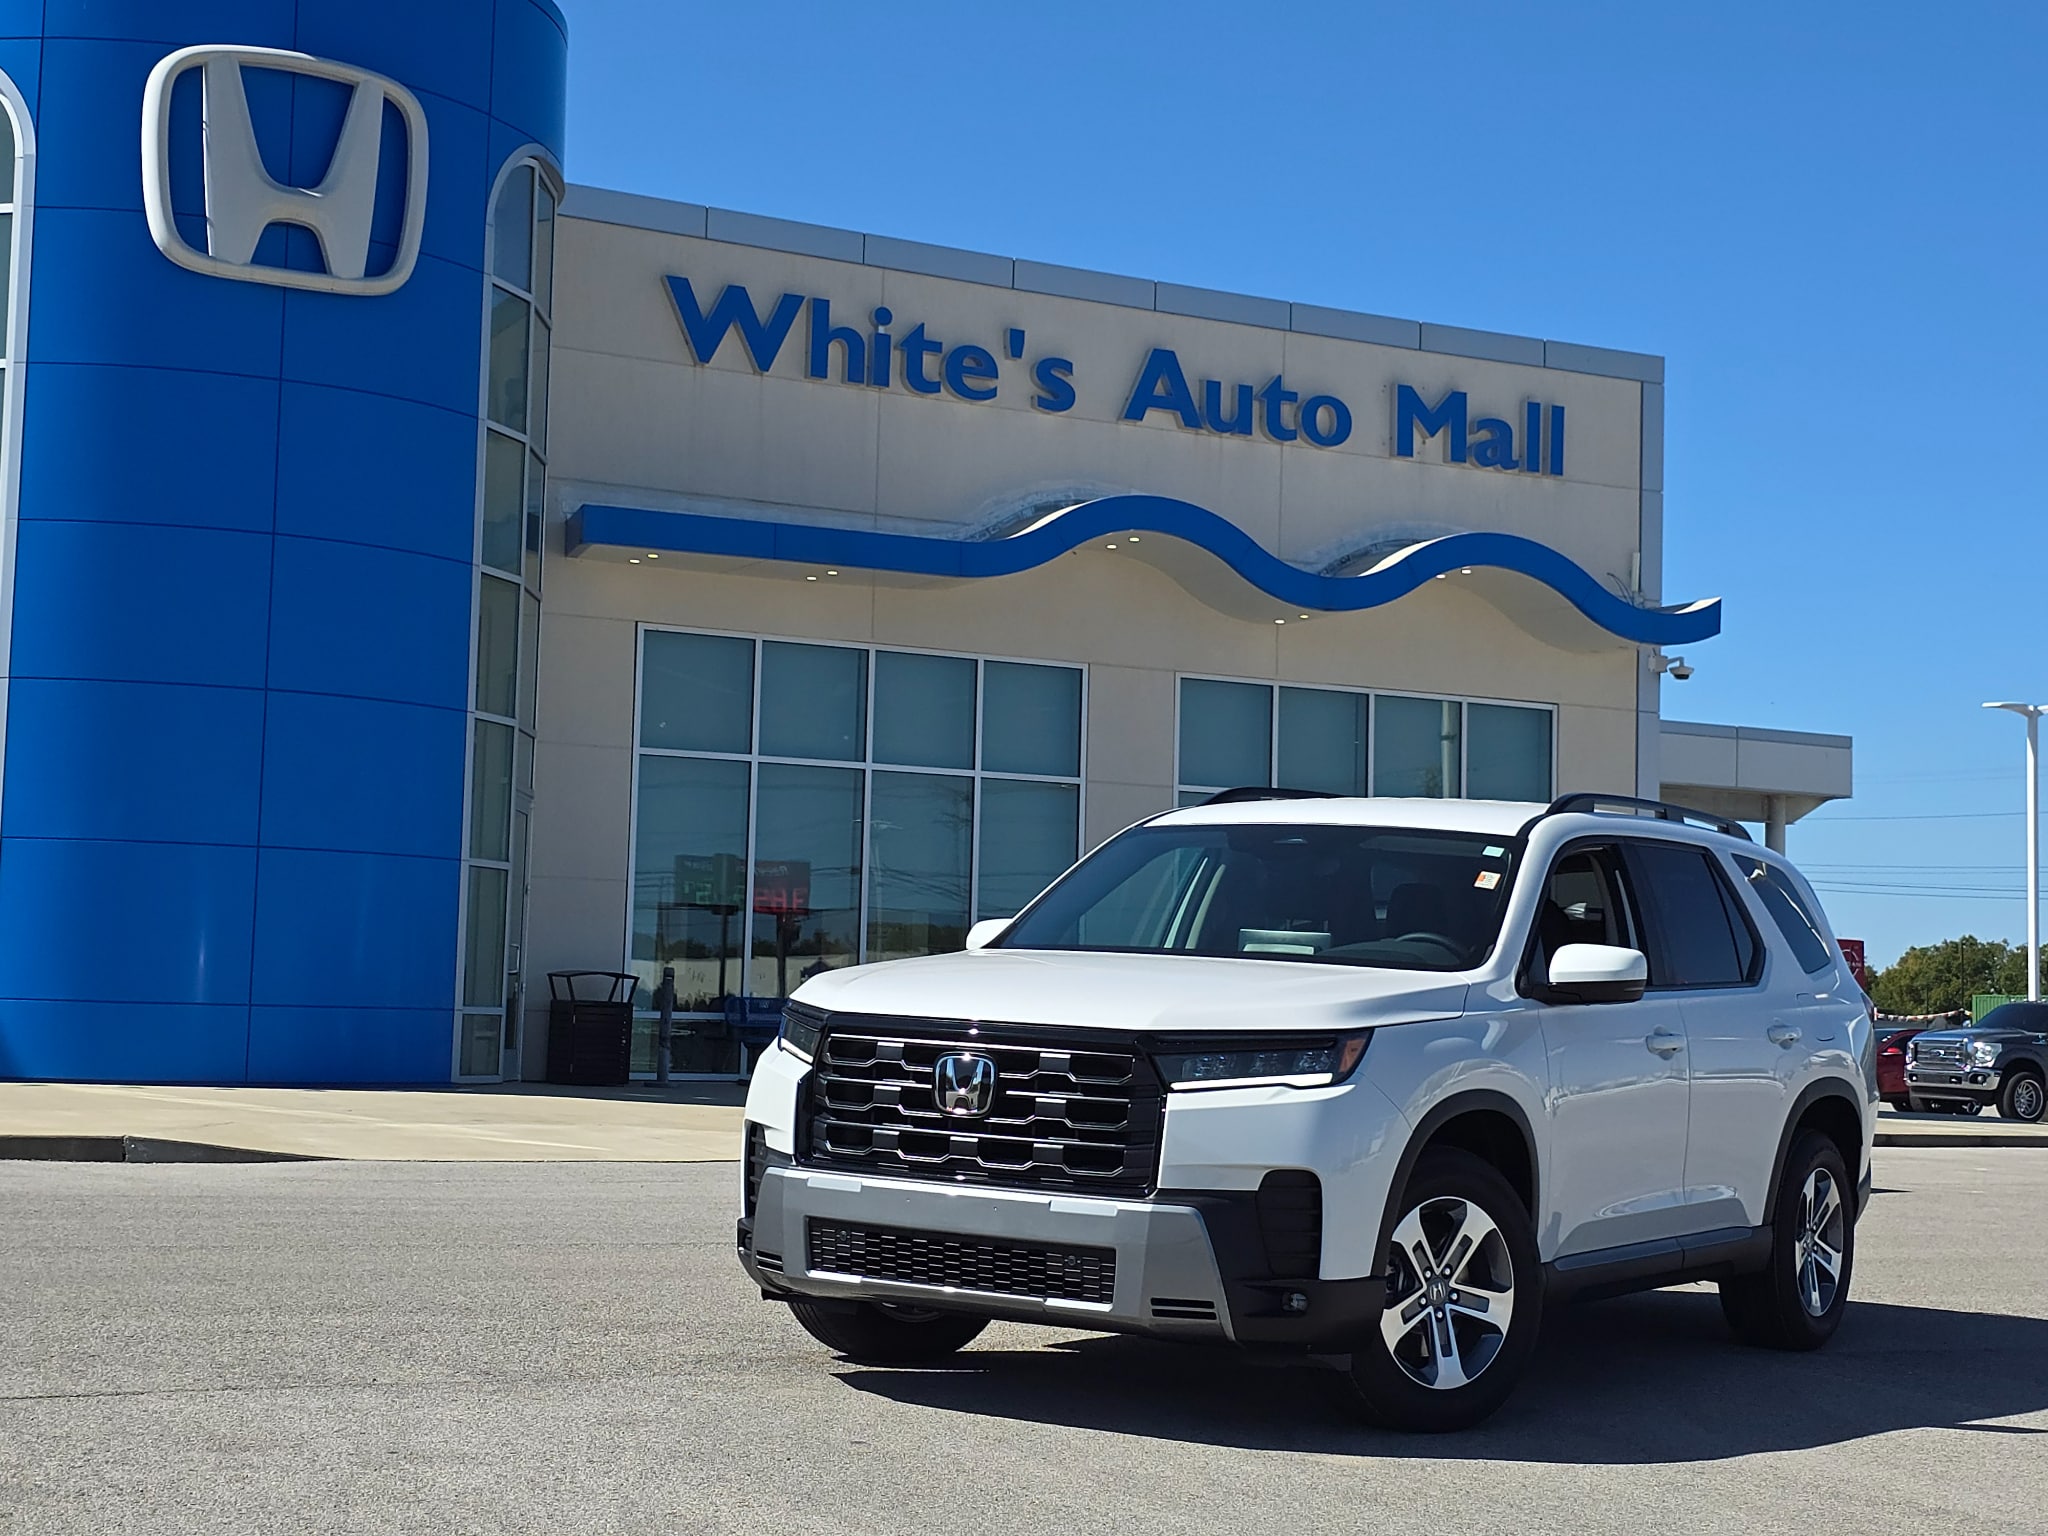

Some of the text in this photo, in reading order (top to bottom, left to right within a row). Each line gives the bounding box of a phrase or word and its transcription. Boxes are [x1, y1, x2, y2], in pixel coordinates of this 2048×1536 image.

[663, 274, 1565, 477] White's Auto Mall
